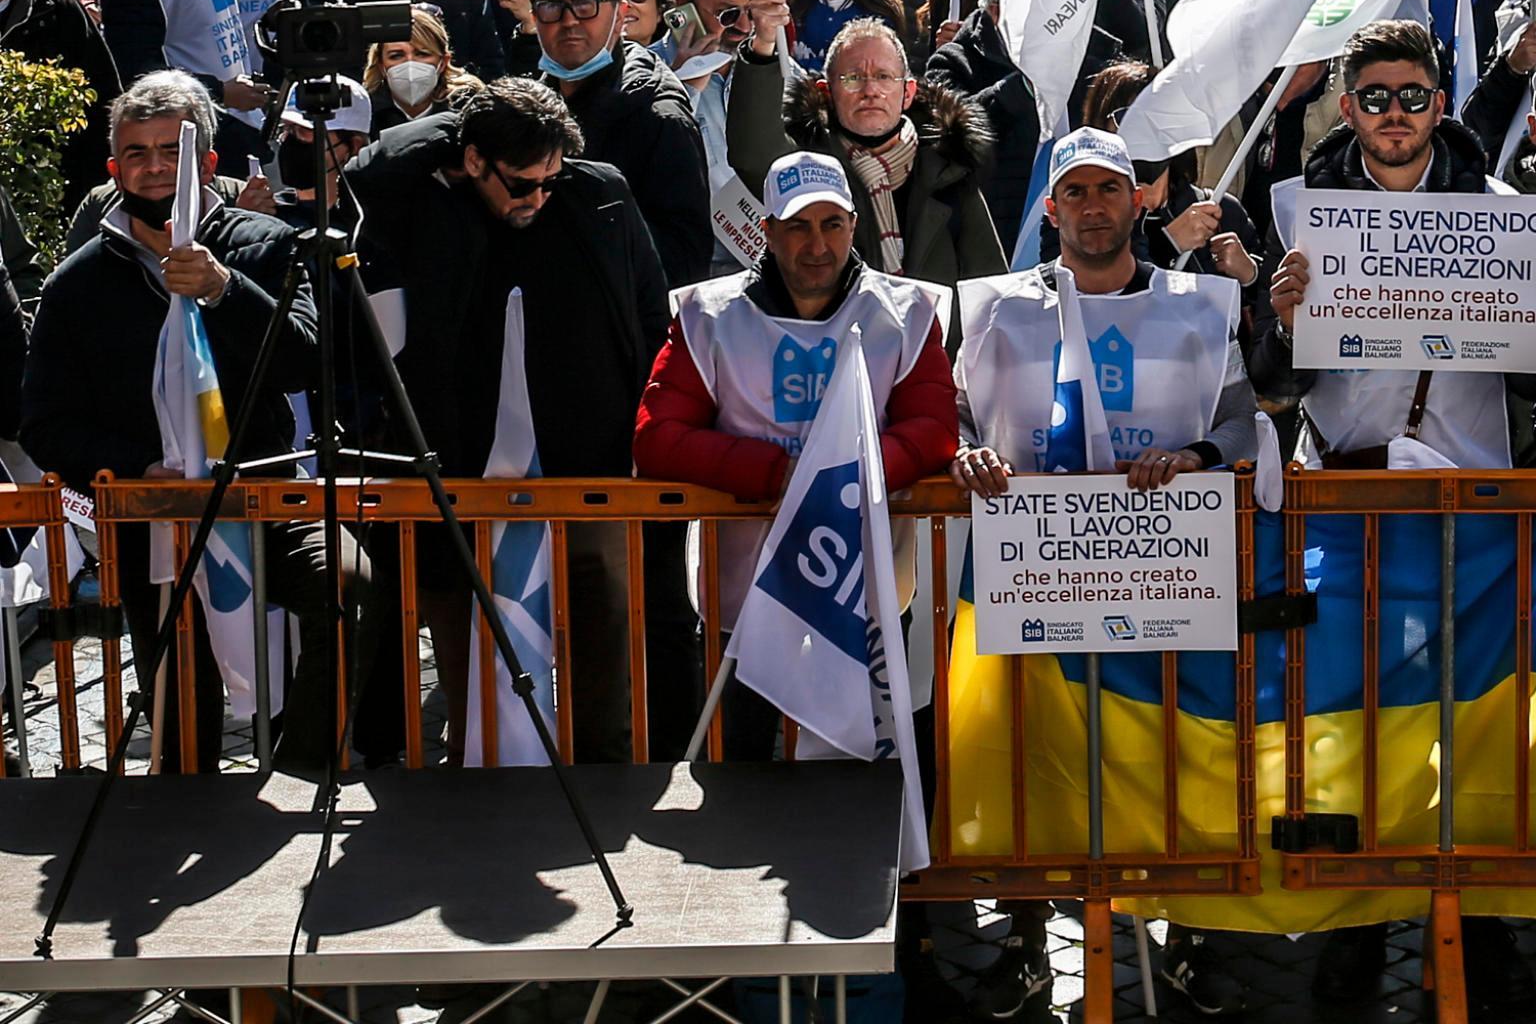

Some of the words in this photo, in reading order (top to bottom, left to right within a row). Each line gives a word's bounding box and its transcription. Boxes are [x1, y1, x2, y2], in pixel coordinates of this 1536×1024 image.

[779, 175, 797, 190] SIB
[801, 168, 842, 183] ITALIANO
[1308, 207, 1382, 229] STATE
[713, 209, 725, 224] LE
[722, 219, 759, 262] IMPRESE
[1360, 233, 1379, 253] IL
[1393, 233, 1496, 256] LAVORO
[1323, 255, 1346, 276] DI
[1361, 256, 1532, 281] GENERAZIONI
[1333, 284, 1372, 301] che
[1378, 284, 1445, 303] hanno
[1451, 288, 1519, 304] creato
[1309, 302, 1453, 321] un'eccellenza
[1341, 343, 1360, 353] SIB
[1461, 341, 1511, 349] FEDERAZIONE
[985, 494, 1057, 516] STATE
[1064, 490, 1222, 514] SVENDENDO
[1037, 517, 1056, 538] IL
[1070, 514, 1172, 538] LAVORO
[1001, 541, 1024, 562] DI
[1039, 537, 1209, 561] GENERAZIONI
[1013, 568, 1051, 586] che
[1057, 568, 1124, 585] hanno
[1130, 566, 1197, 583] creato
[990, 584, 1133, 604] un'eccellenza
[1139, 583, 1222, 601] italiana.
[1024, 628, 1042, 638] SIB
[1047, 627, 1084, 635] ITALIANO
[1047, 634, 1084, 642] BALNEARI
